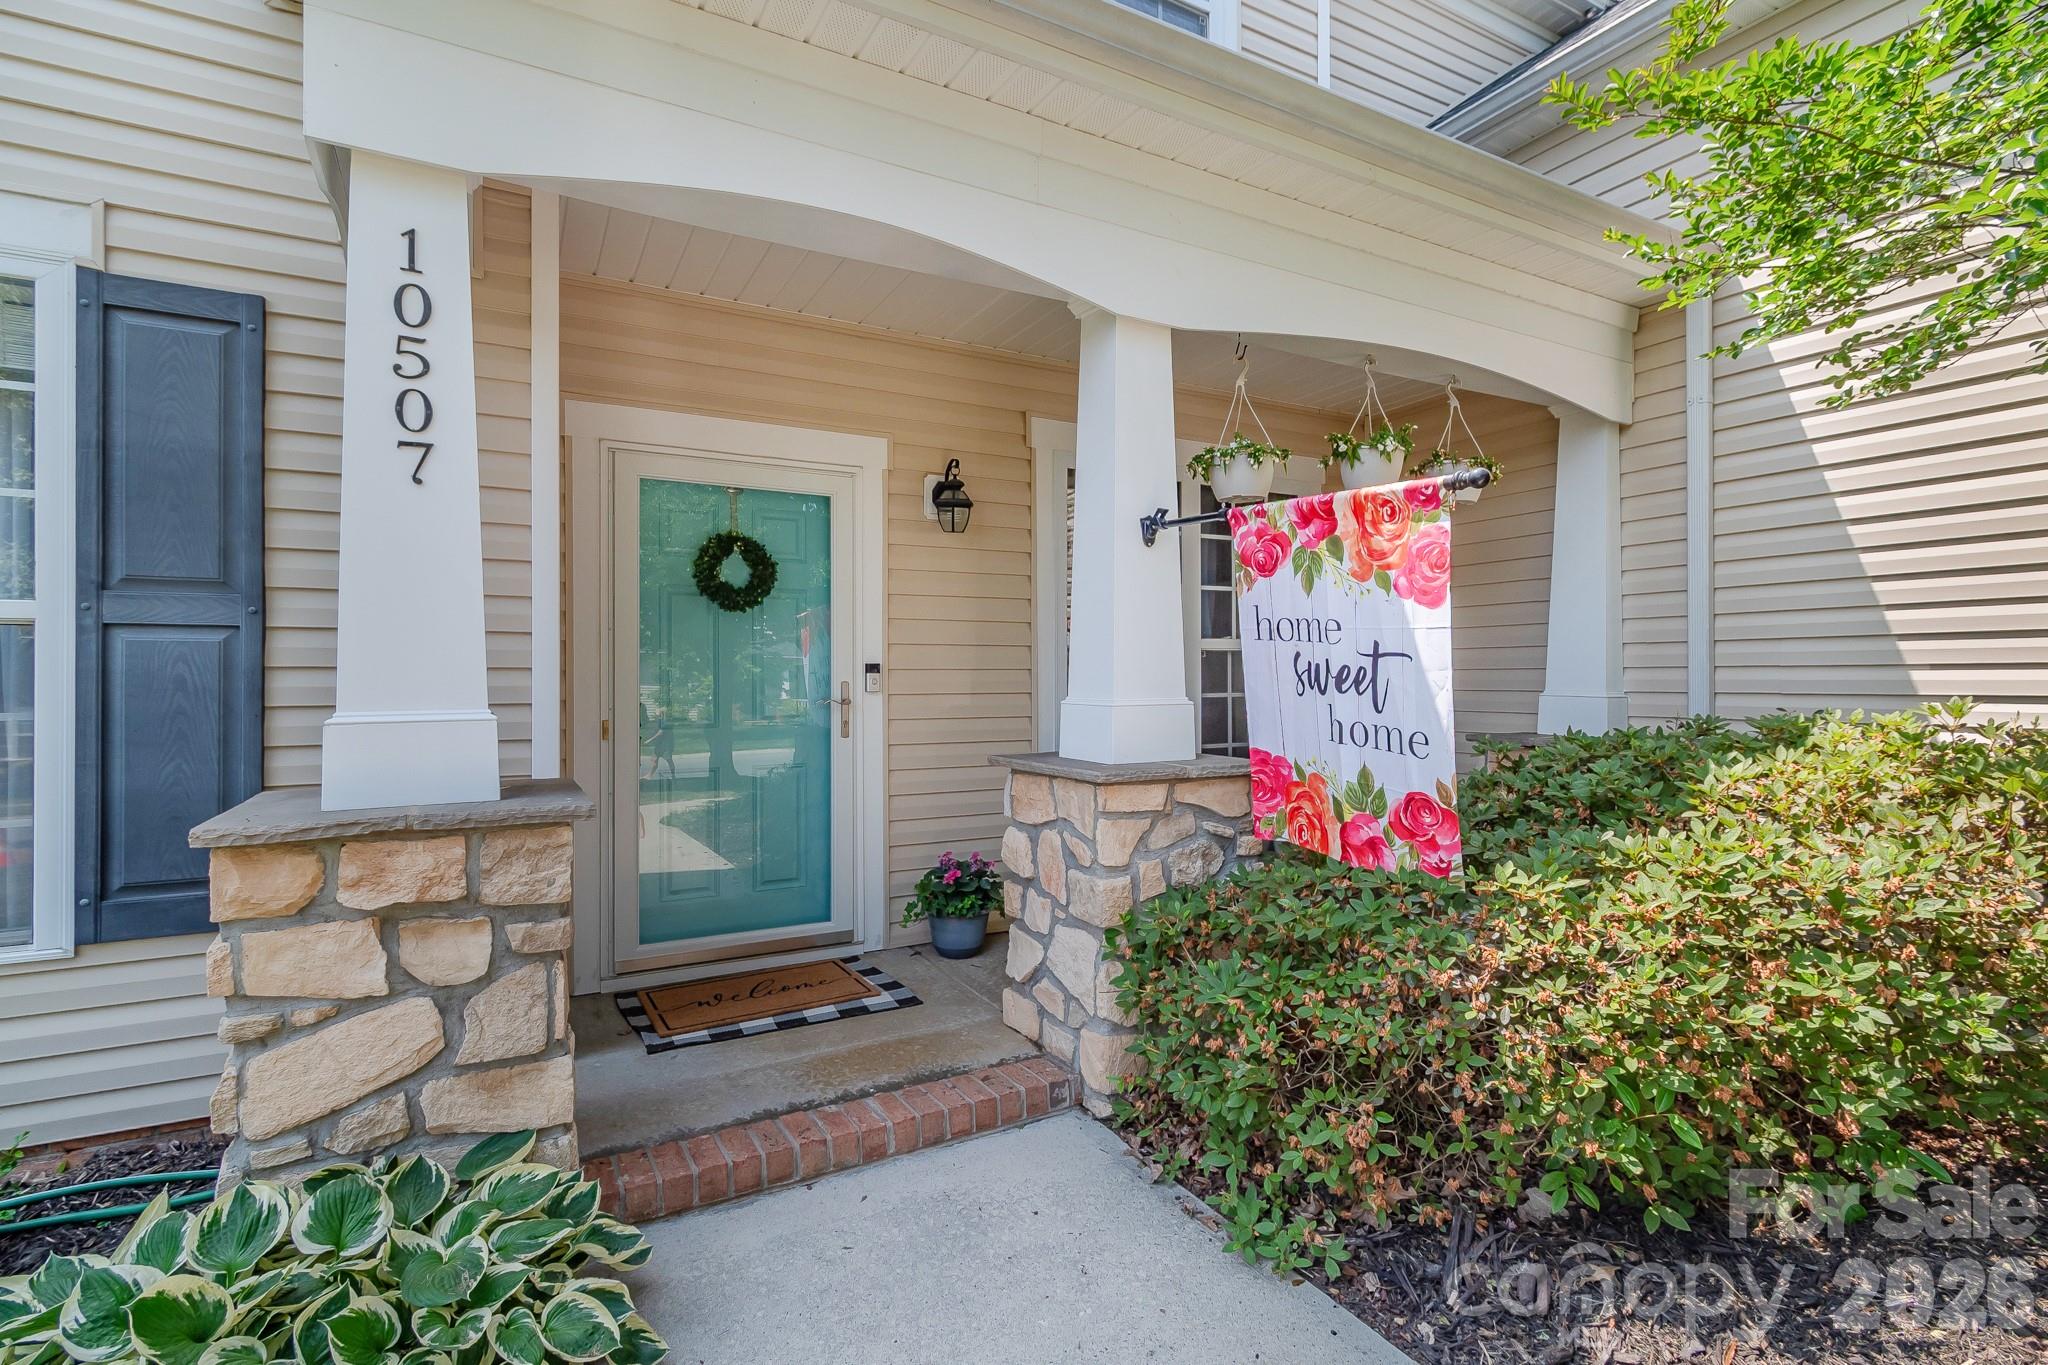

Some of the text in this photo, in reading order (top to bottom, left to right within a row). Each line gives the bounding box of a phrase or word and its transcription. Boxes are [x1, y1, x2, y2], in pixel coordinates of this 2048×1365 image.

[393, 228, 434, 485] 10507
[1253, 604, 1342, 645] home
[1293, 640, 1413, 714] sweet
[1327, 703, 1430, 760] home
[687, 979, 837, 1009] welcome
